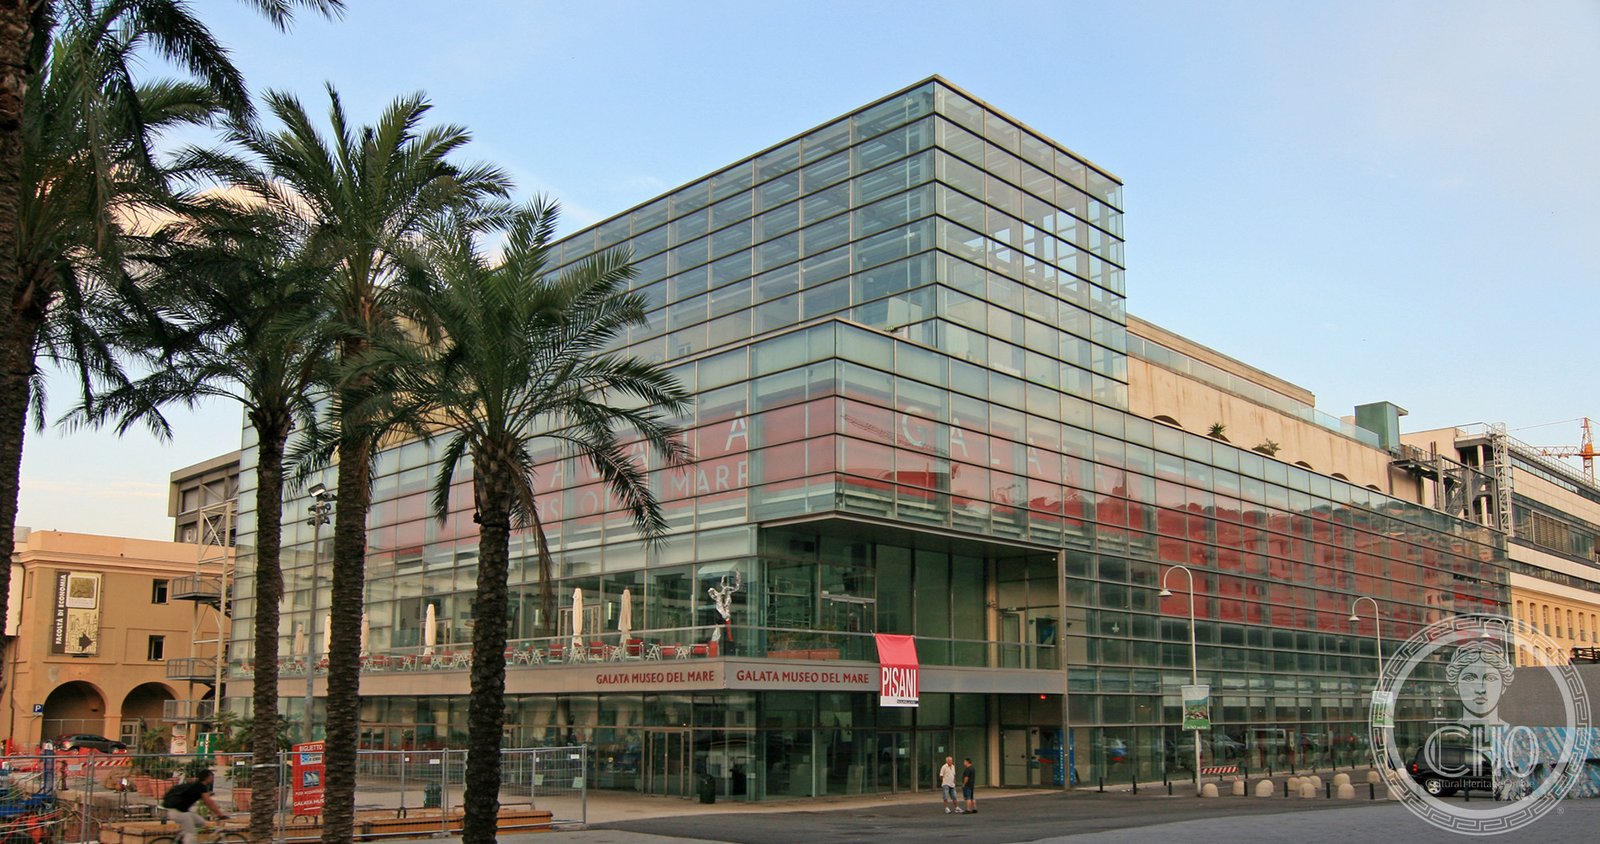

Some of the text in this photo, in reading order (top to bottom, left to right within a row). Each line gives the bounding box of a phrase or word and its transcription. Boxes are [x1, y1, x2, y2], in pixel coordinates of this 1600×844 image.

[58, 574, 66, 608] ECONOMIA
[596, 670, 714, 684] GALATA MUSEO DEL MARE
[736, 670, 869, 684] GALATA MUSEO DEL MARE
[882, 666, 916, 698] PISANI
